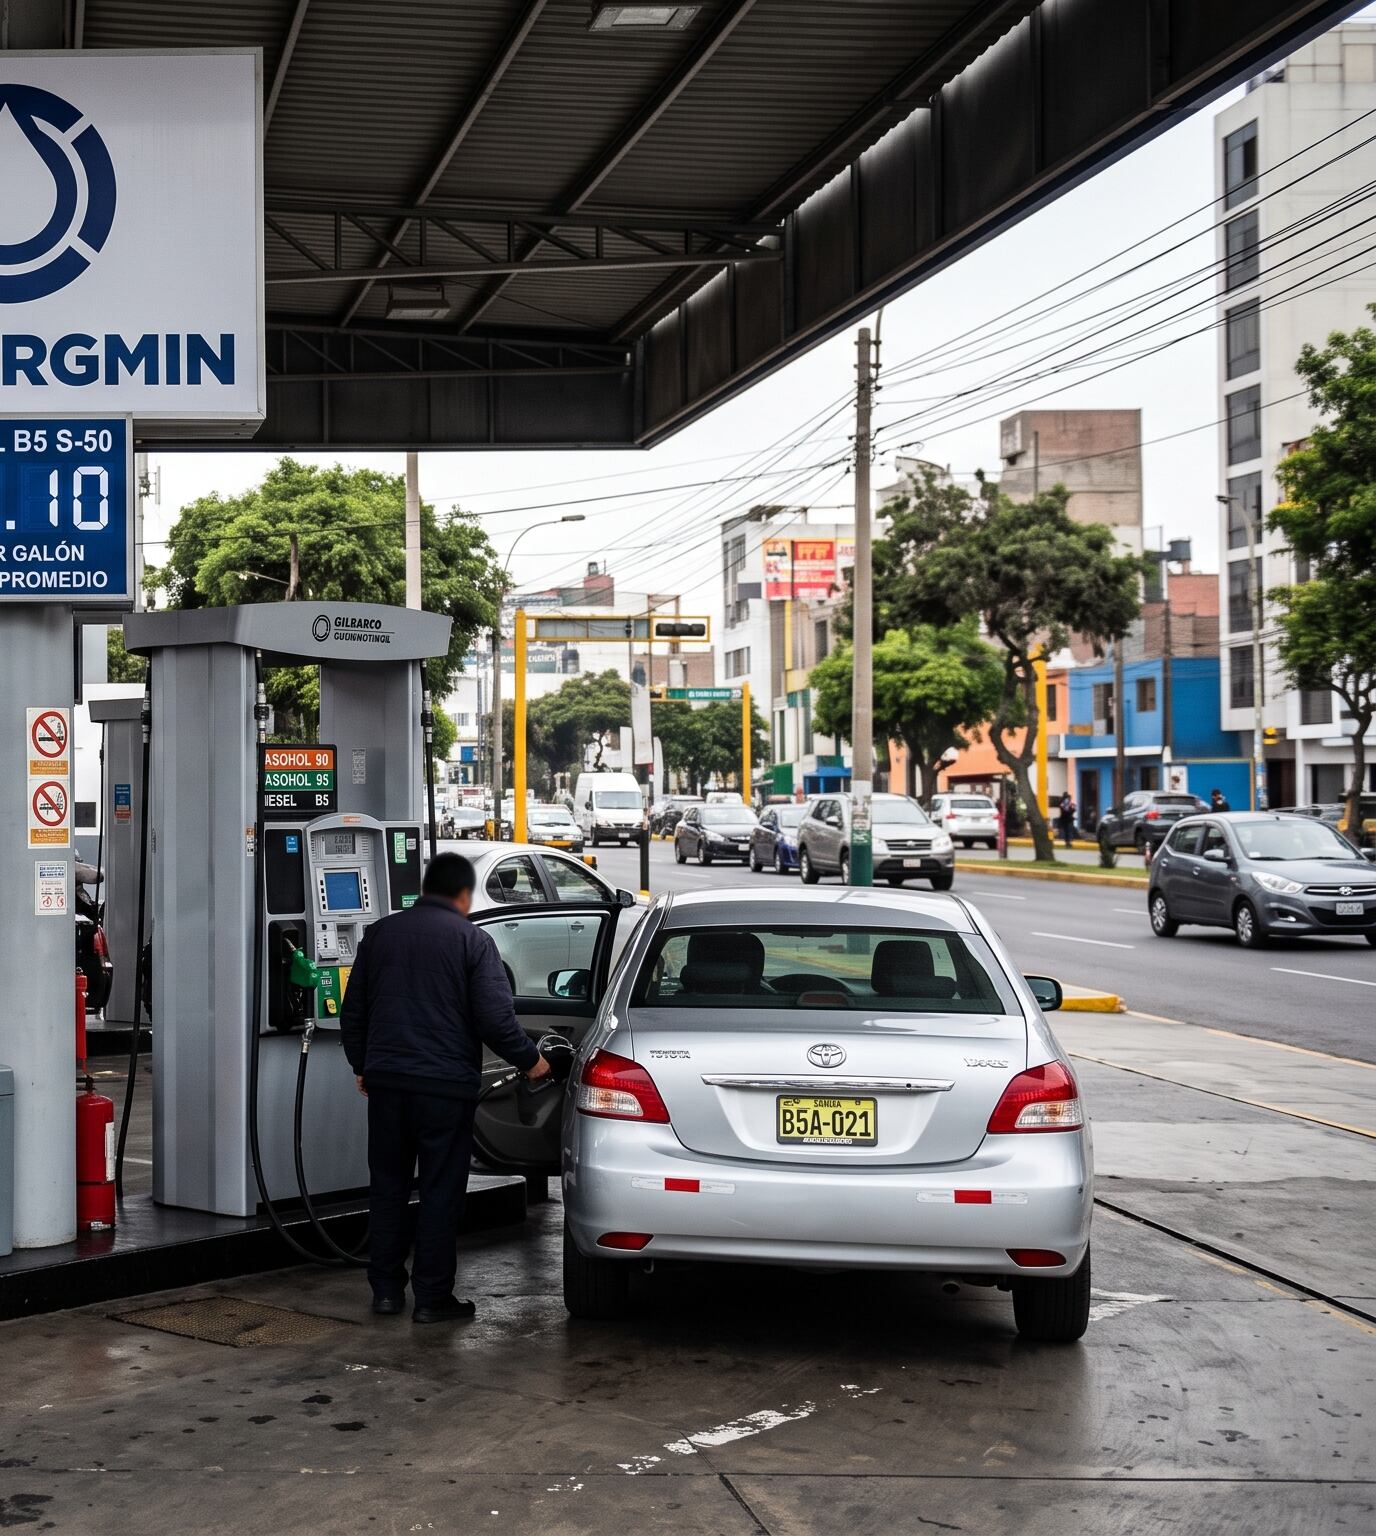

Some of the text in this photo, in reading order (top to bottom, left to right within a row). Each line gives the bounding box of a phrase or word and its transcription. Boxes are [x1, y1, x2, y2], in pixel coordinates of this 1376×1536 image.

[14, 429, 47, 453] B5
[56, 428, 113, 453] S-50
[12, 540, 85, 562] GALÓN
[265, 753, 329, 766] ASOHOL 90
[265, 773, 329, 786] ASOHOL 95
[264, 794, 329, 807] IESEL B5
[782, 1109, 871, 1137] B5A-021
